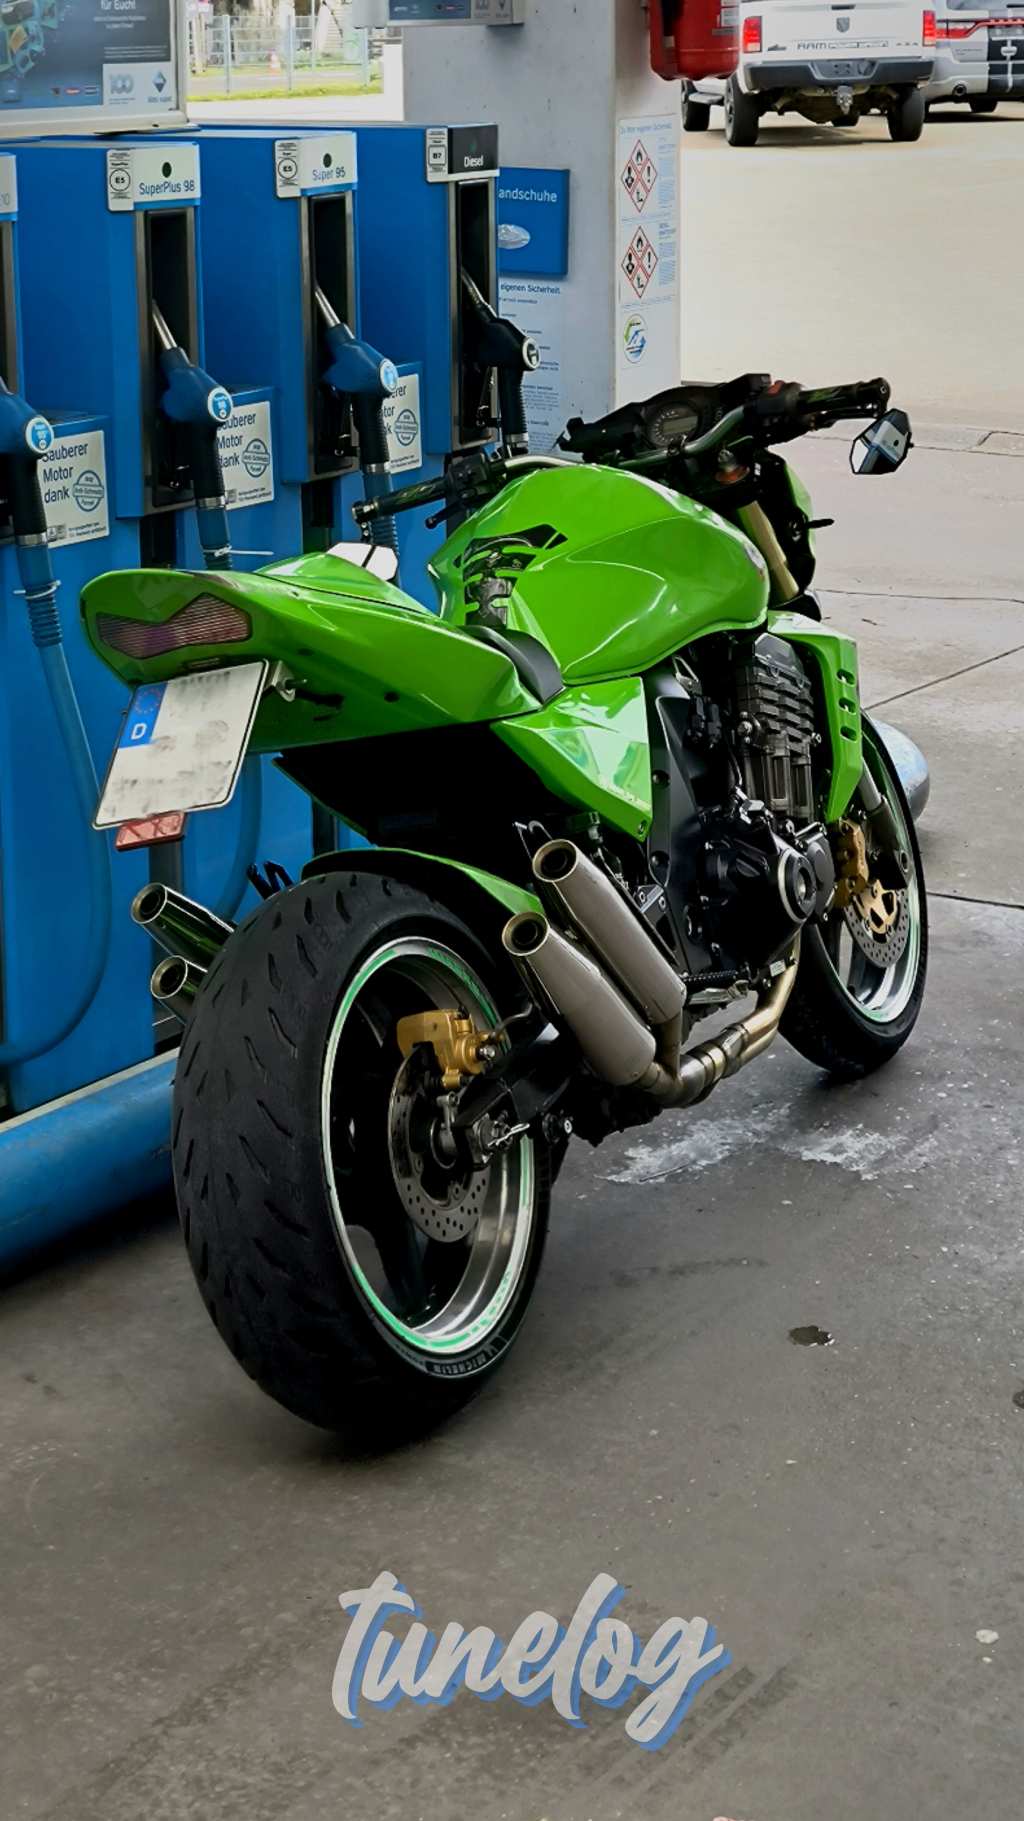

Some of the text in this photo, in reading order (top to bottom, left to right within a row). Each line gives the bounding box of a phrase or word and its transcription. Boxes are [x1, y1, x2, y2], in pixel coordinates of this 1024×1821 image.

[282, 164, 293, 172] E5
[464, 155, 484, 168] Diesel
[115, 176, 126, 184] E5
[312, 166, 346, 183] Super 95
[139, 181, 182, 196] SuperPlus
[183, 180, 195, 192] 98
[498, 187, 558, 203] andschuhe
[218, 413, 257, 432] auberer
[43, 466, 74, 483] Motor
[44, 486, 70, 504] dank
[131, 723, 147, 740] D
[432, 1355, 487, 1375] MICHELIN
